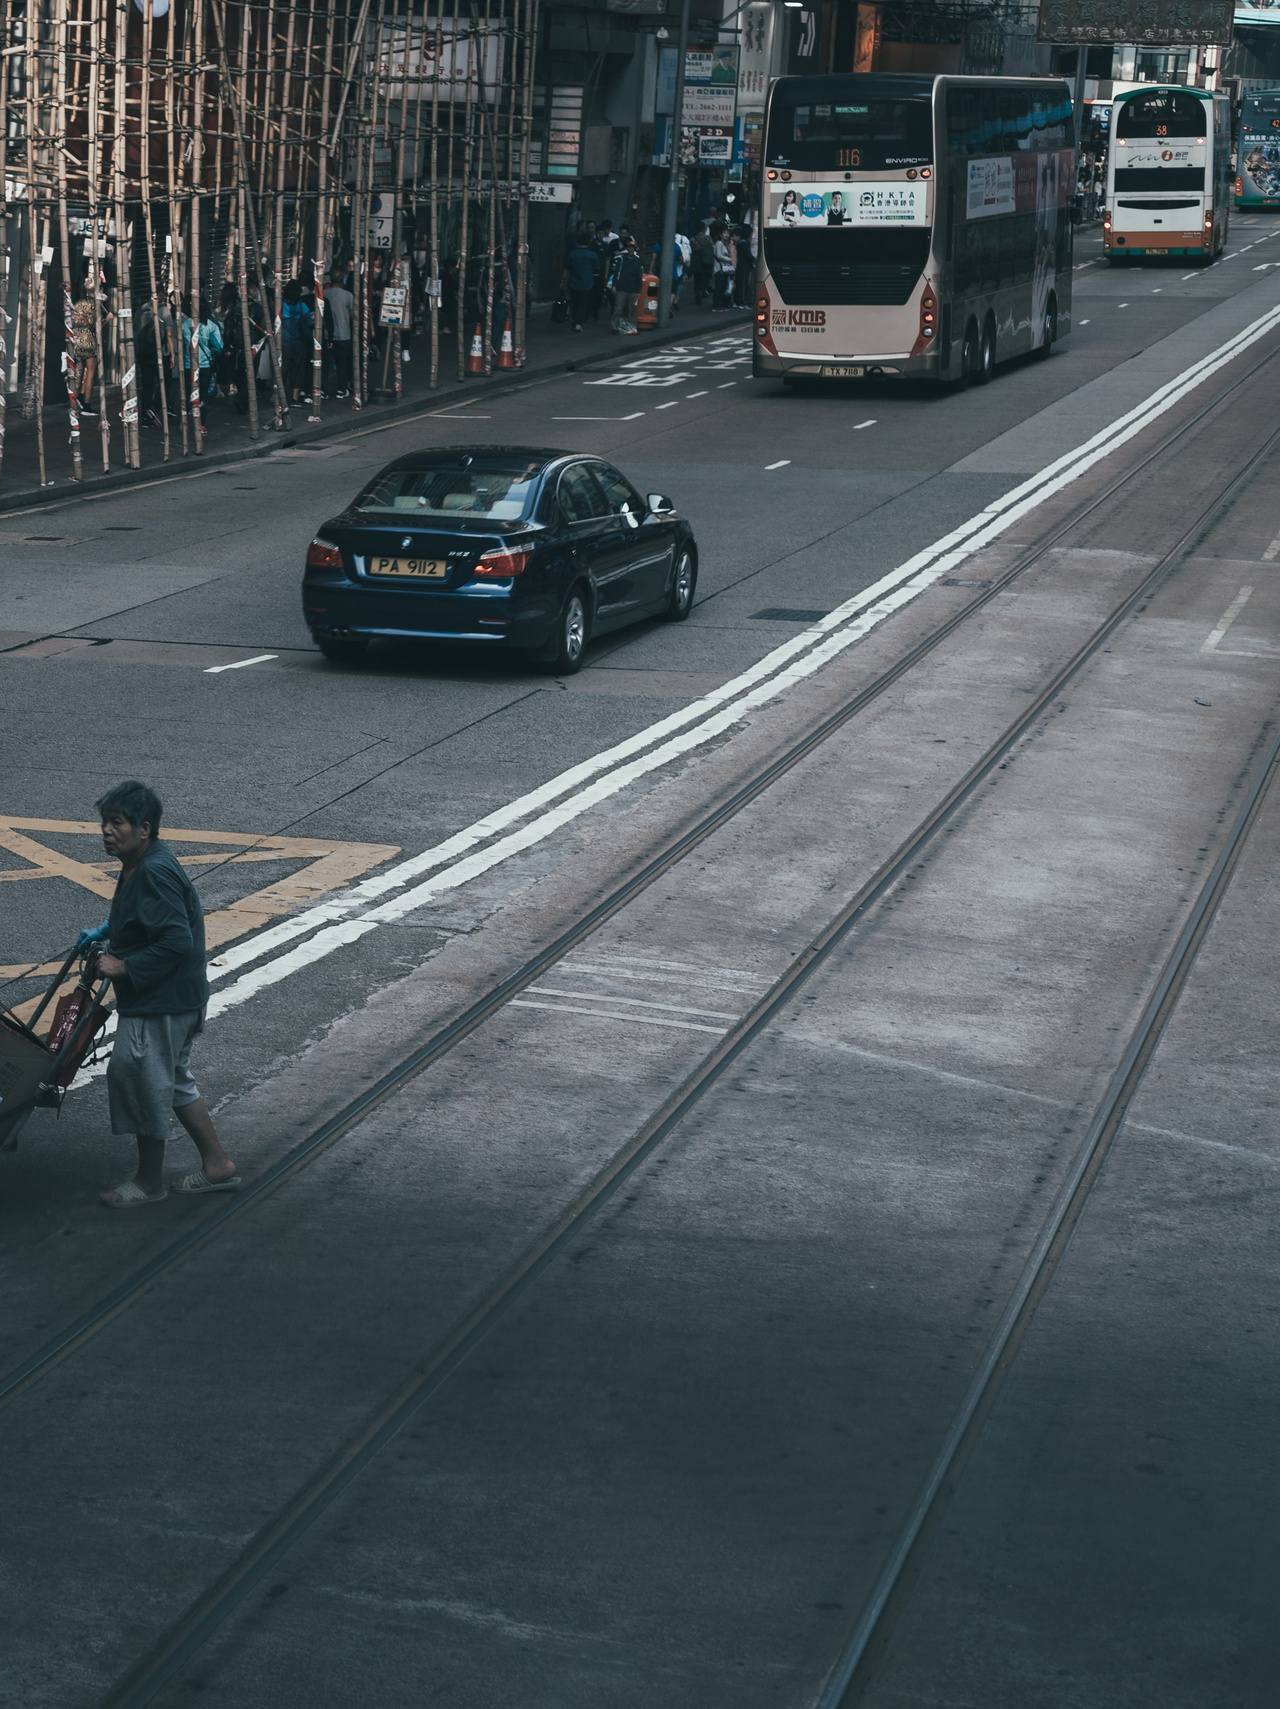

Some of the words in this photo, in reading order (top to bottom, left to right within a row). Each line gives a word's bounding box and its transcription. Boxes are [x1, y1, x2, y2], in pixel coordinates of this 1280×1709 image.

[1156, 125, 1168, 136] 38
[839, 148, 860, 166] 116
[376, 219, 385, 230] 7
[376, 236, 390, 246] 12
[788, 309, 827, 326] KMB
[830, 367, 840, 376] TX
[379, 559, 400, 573] PA
[407, 560, 437, 575] 9112
